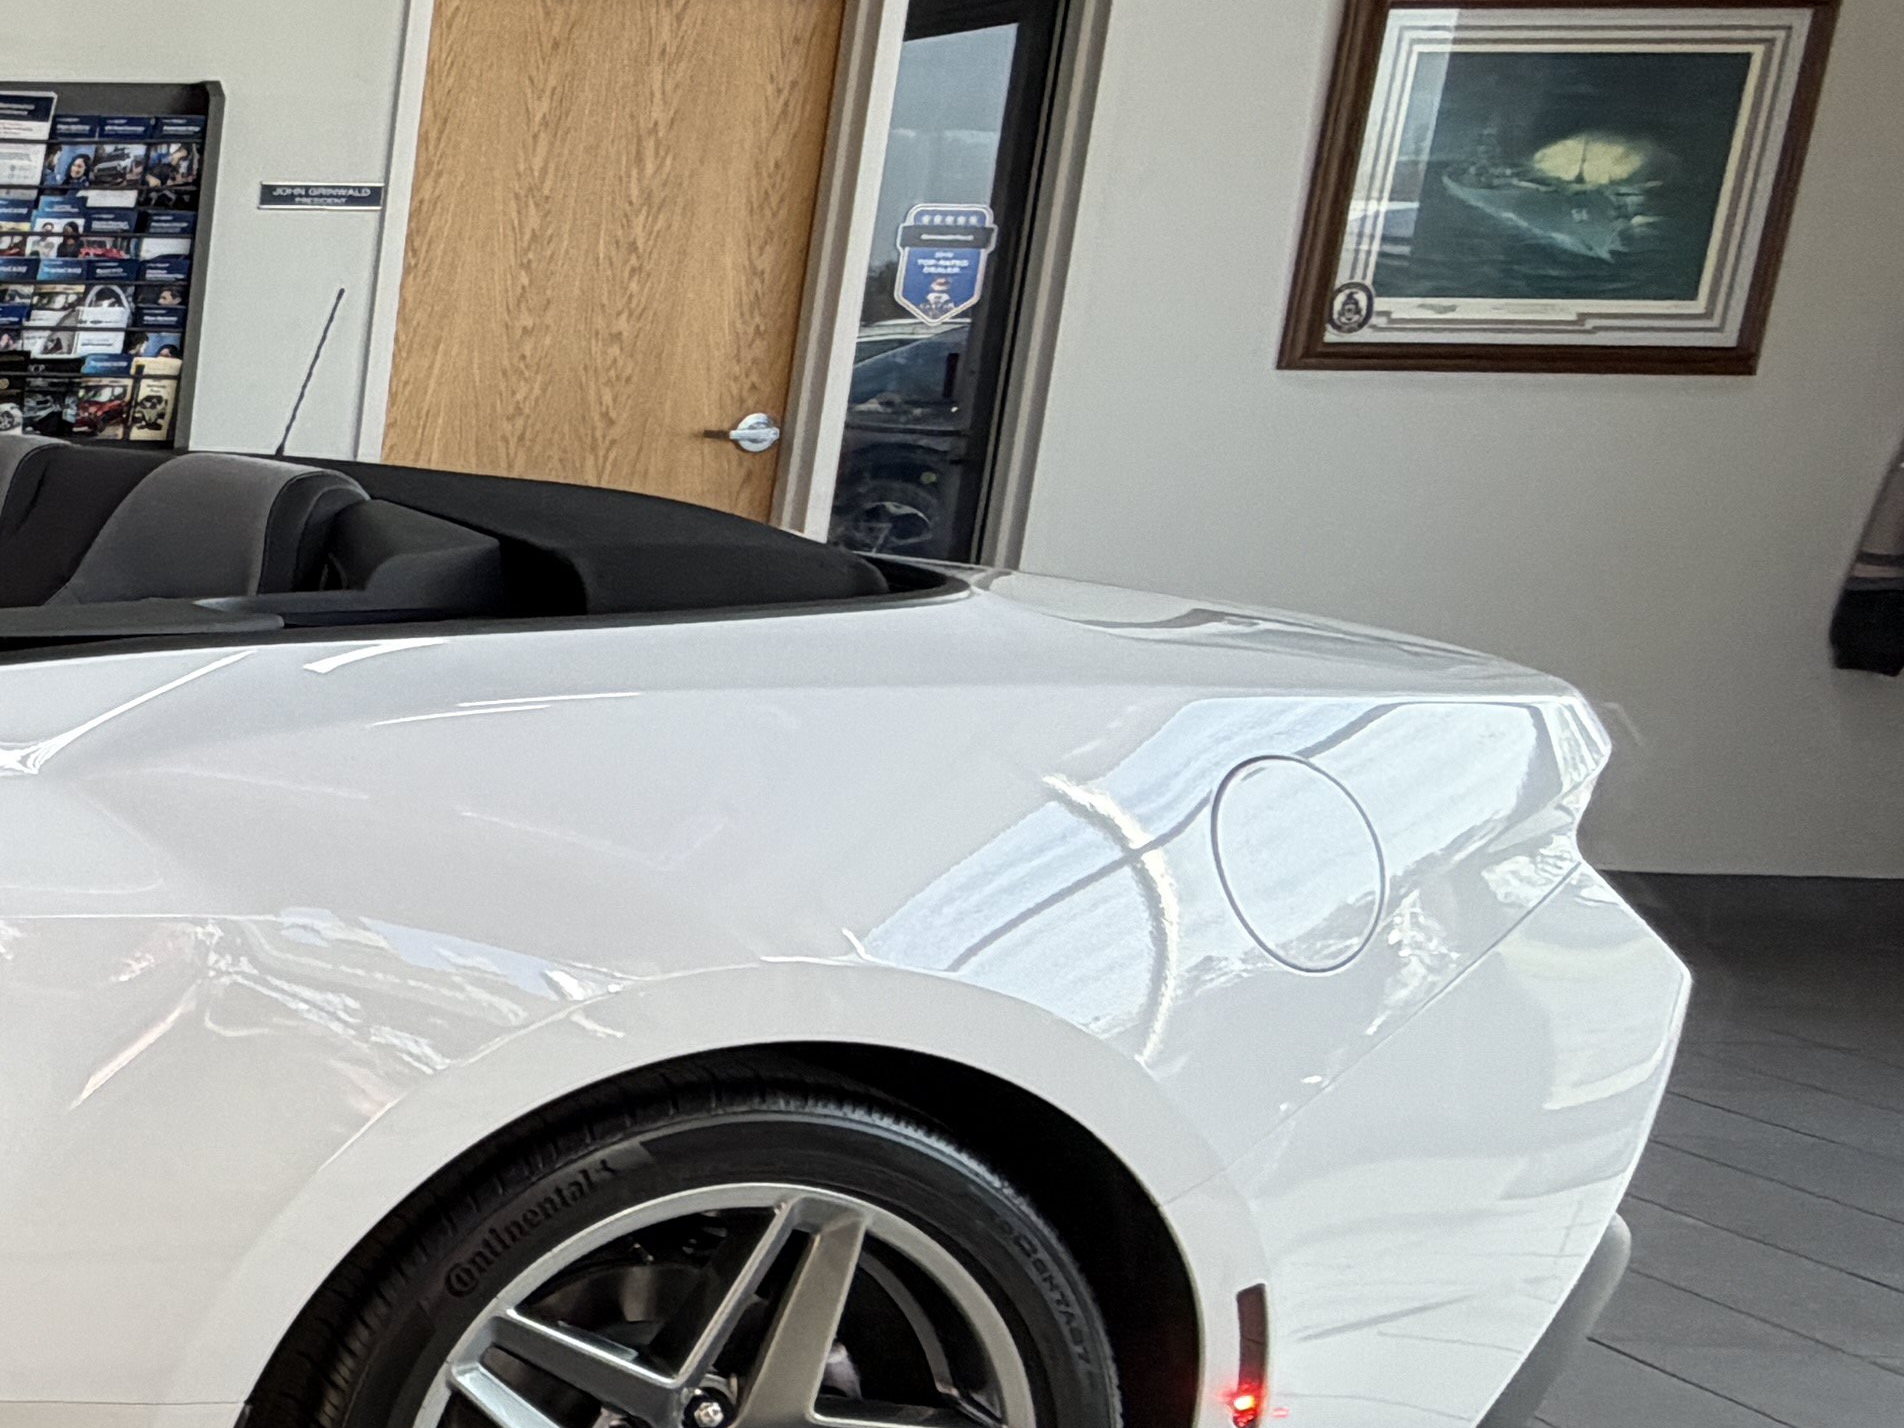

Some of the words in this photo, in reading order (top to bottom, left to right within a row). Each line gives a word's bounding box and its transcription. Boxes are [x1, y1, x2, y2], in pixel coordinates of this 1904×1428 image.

[272, 187, 305, 196] JOHN
[308, 187, 371, 197] GRINWALD
[444, 1168, 595, 1298] Continental
